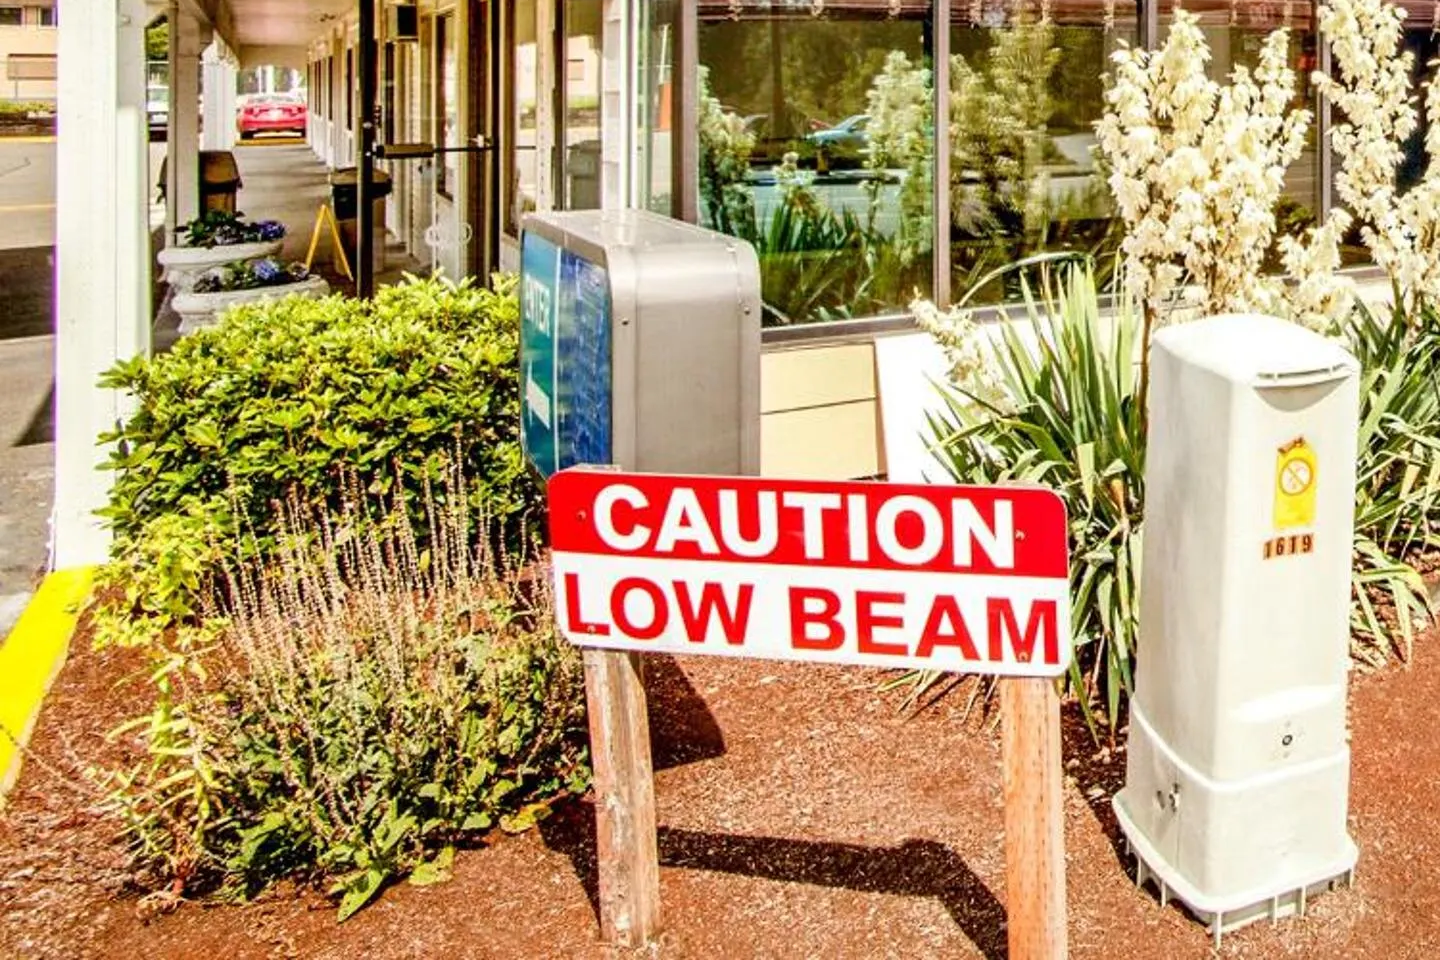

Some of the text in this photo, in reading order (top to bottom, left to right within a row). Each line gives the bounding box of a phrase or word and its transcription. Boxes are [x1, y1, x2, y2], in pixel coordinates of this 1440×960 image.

[593, 483, 1015, 569] CAUTION
[1263, 533, 1314, 560] 1619
[564, 572, 1060, 665] LOW BEAM
